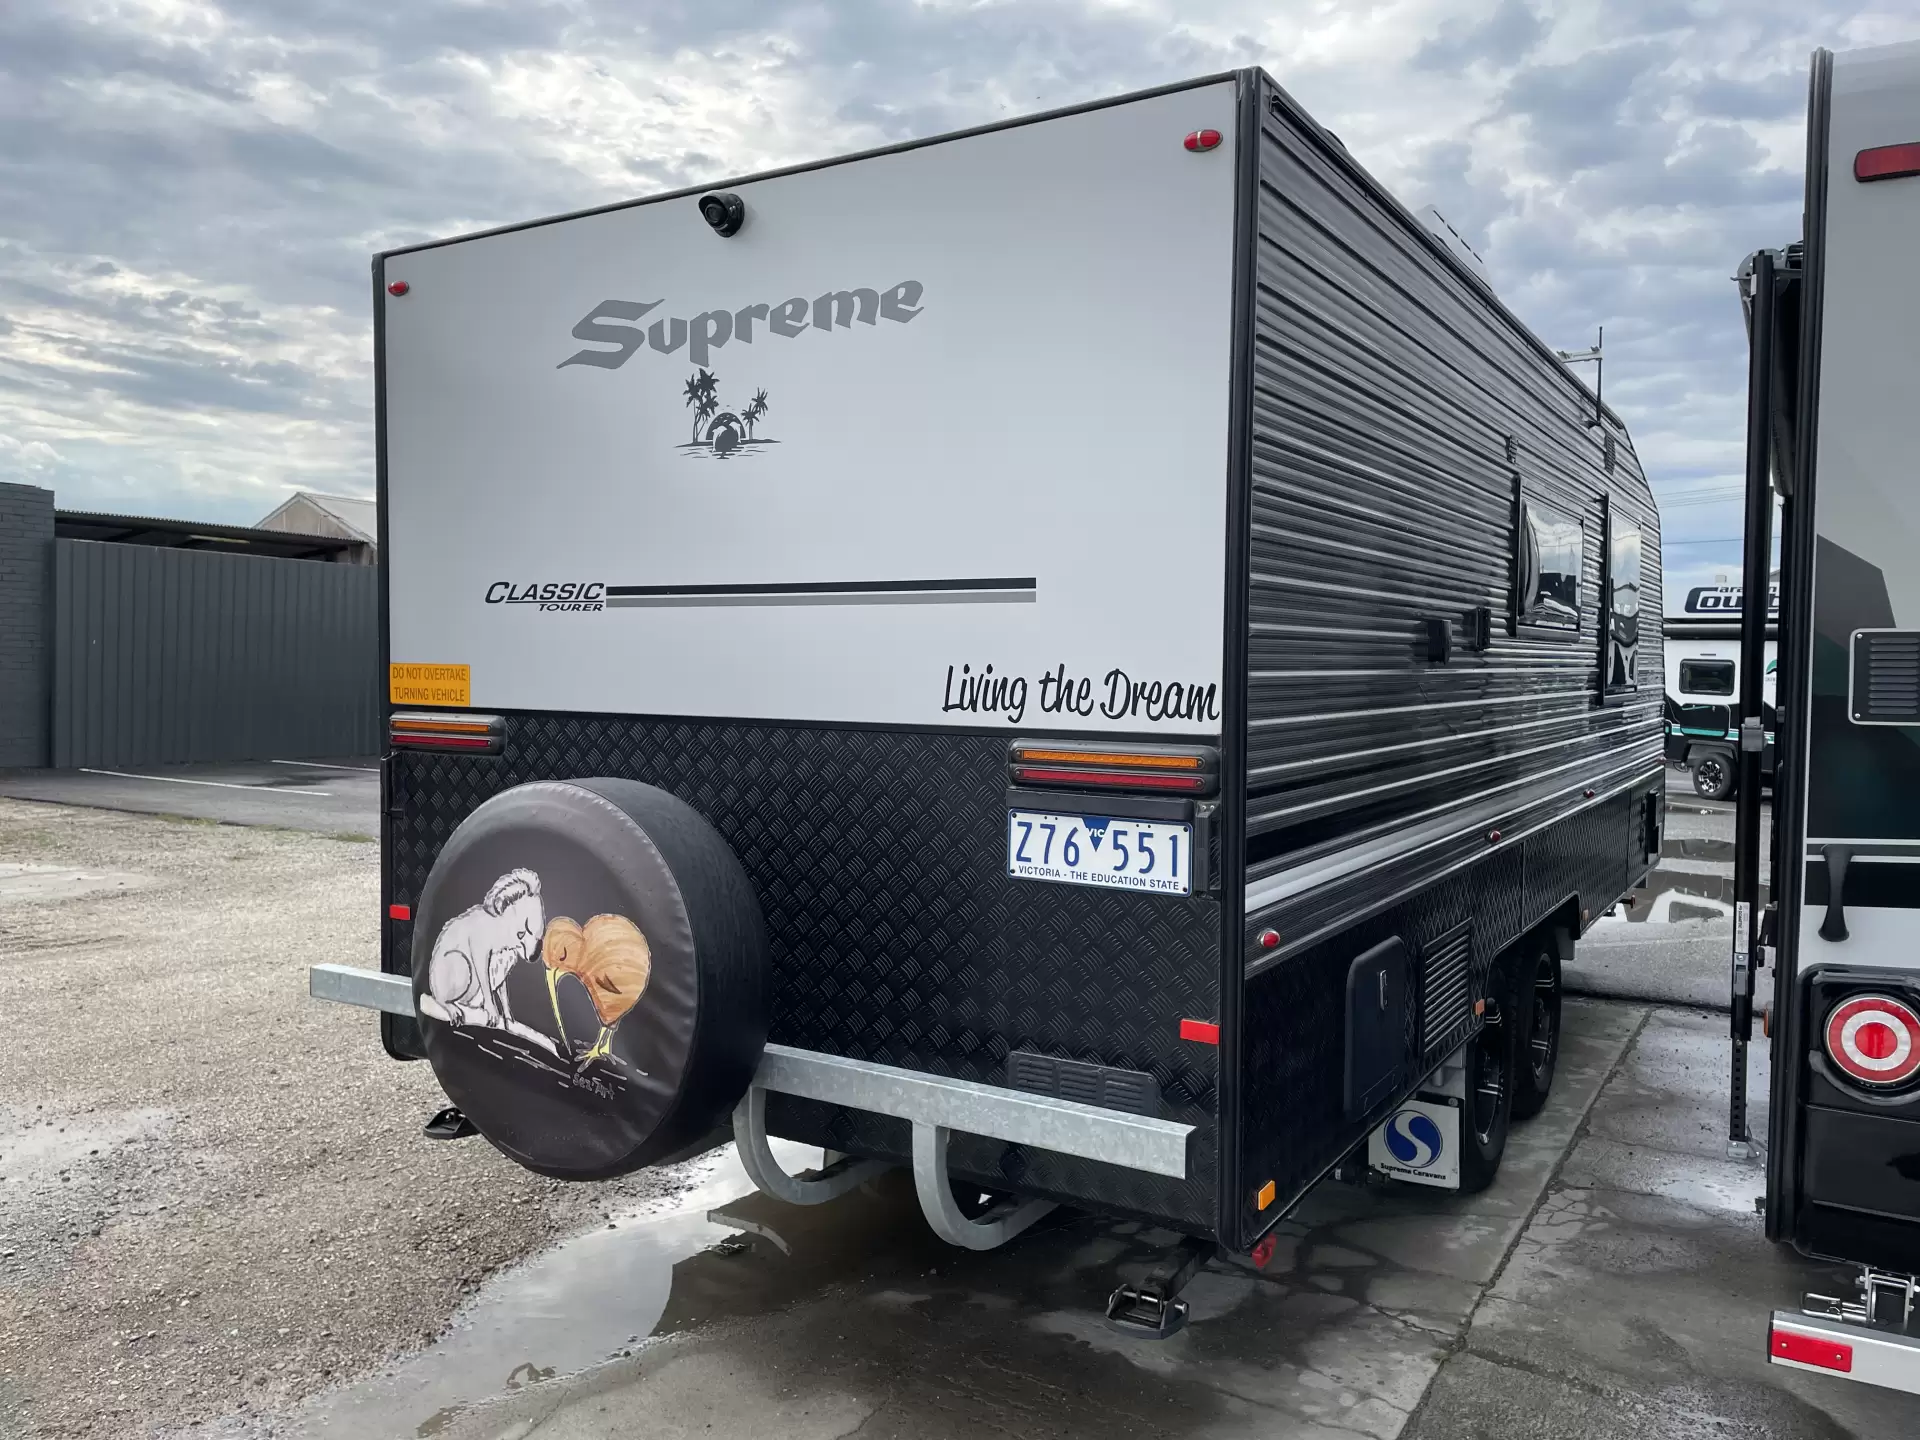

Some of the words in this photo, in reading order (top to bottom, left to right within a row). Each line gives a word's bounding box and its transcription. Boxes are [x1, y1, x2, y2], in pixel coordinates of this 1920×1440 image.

[556, 280, 924, 370] Supreme
[539, 603, 604, 612] TOURER
[392, 666, 405, 679] DO
[406, 667, 422, 680] NOT
[424, 667, 467, 681] OVERTAKE
[394, 687, 429, 700] TURNING
[431, 688, 465, 702] VEHICLE
[942, 663, 1028, 723] Living
[1038, 663, 1094, 717] the
[1100, 668, 1220, 722] Dream
[1016, 821, 1080, 867] Z76
[1112, 829, 1179, 878] 551
[1018, 865, 1061, 878] VICTORIA
[1070, 870, 1088, 881] THE
[1091, 873, 1146, 887] EDUCATION
[1149, 879, 1180, 891] STATE
[1380, 1162, 1412, 1175] Supreme
[1412, 1169, 1447, 1180] Caravans
